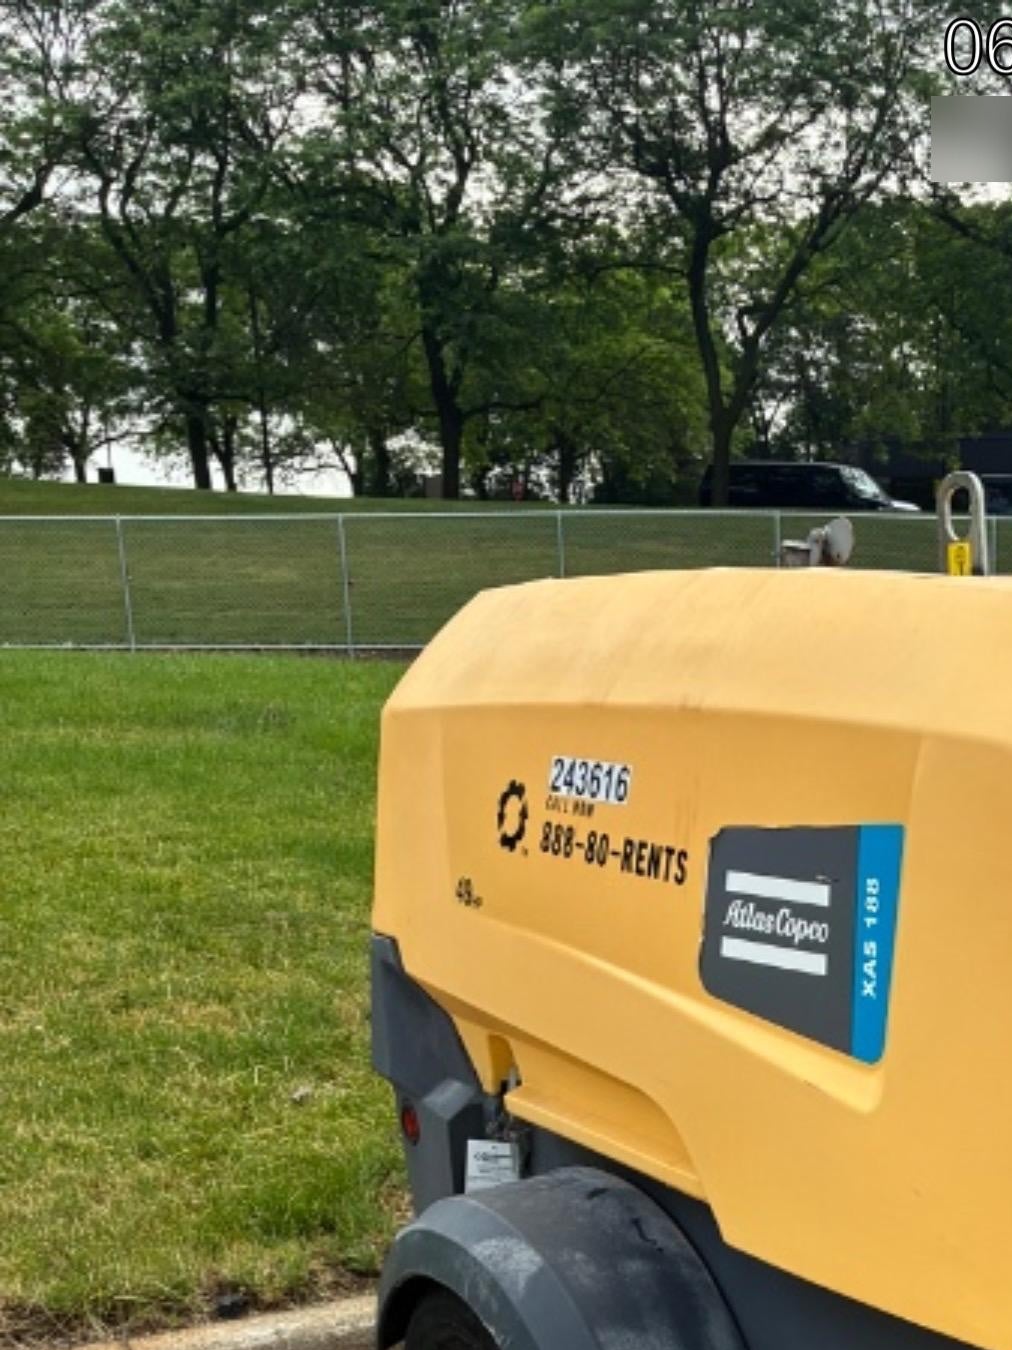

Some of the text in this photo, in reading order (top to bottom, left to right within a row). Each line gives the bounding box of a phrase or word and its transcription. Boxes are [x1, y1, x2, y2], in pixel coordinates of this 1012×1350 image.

[550, 758, 631, 802] 243616
[540, 821, 688, 886] 888-80-RENTS
[723, 899, 829, 946] Atlas Copco
[862, 877, 881, 999] XAS 188
